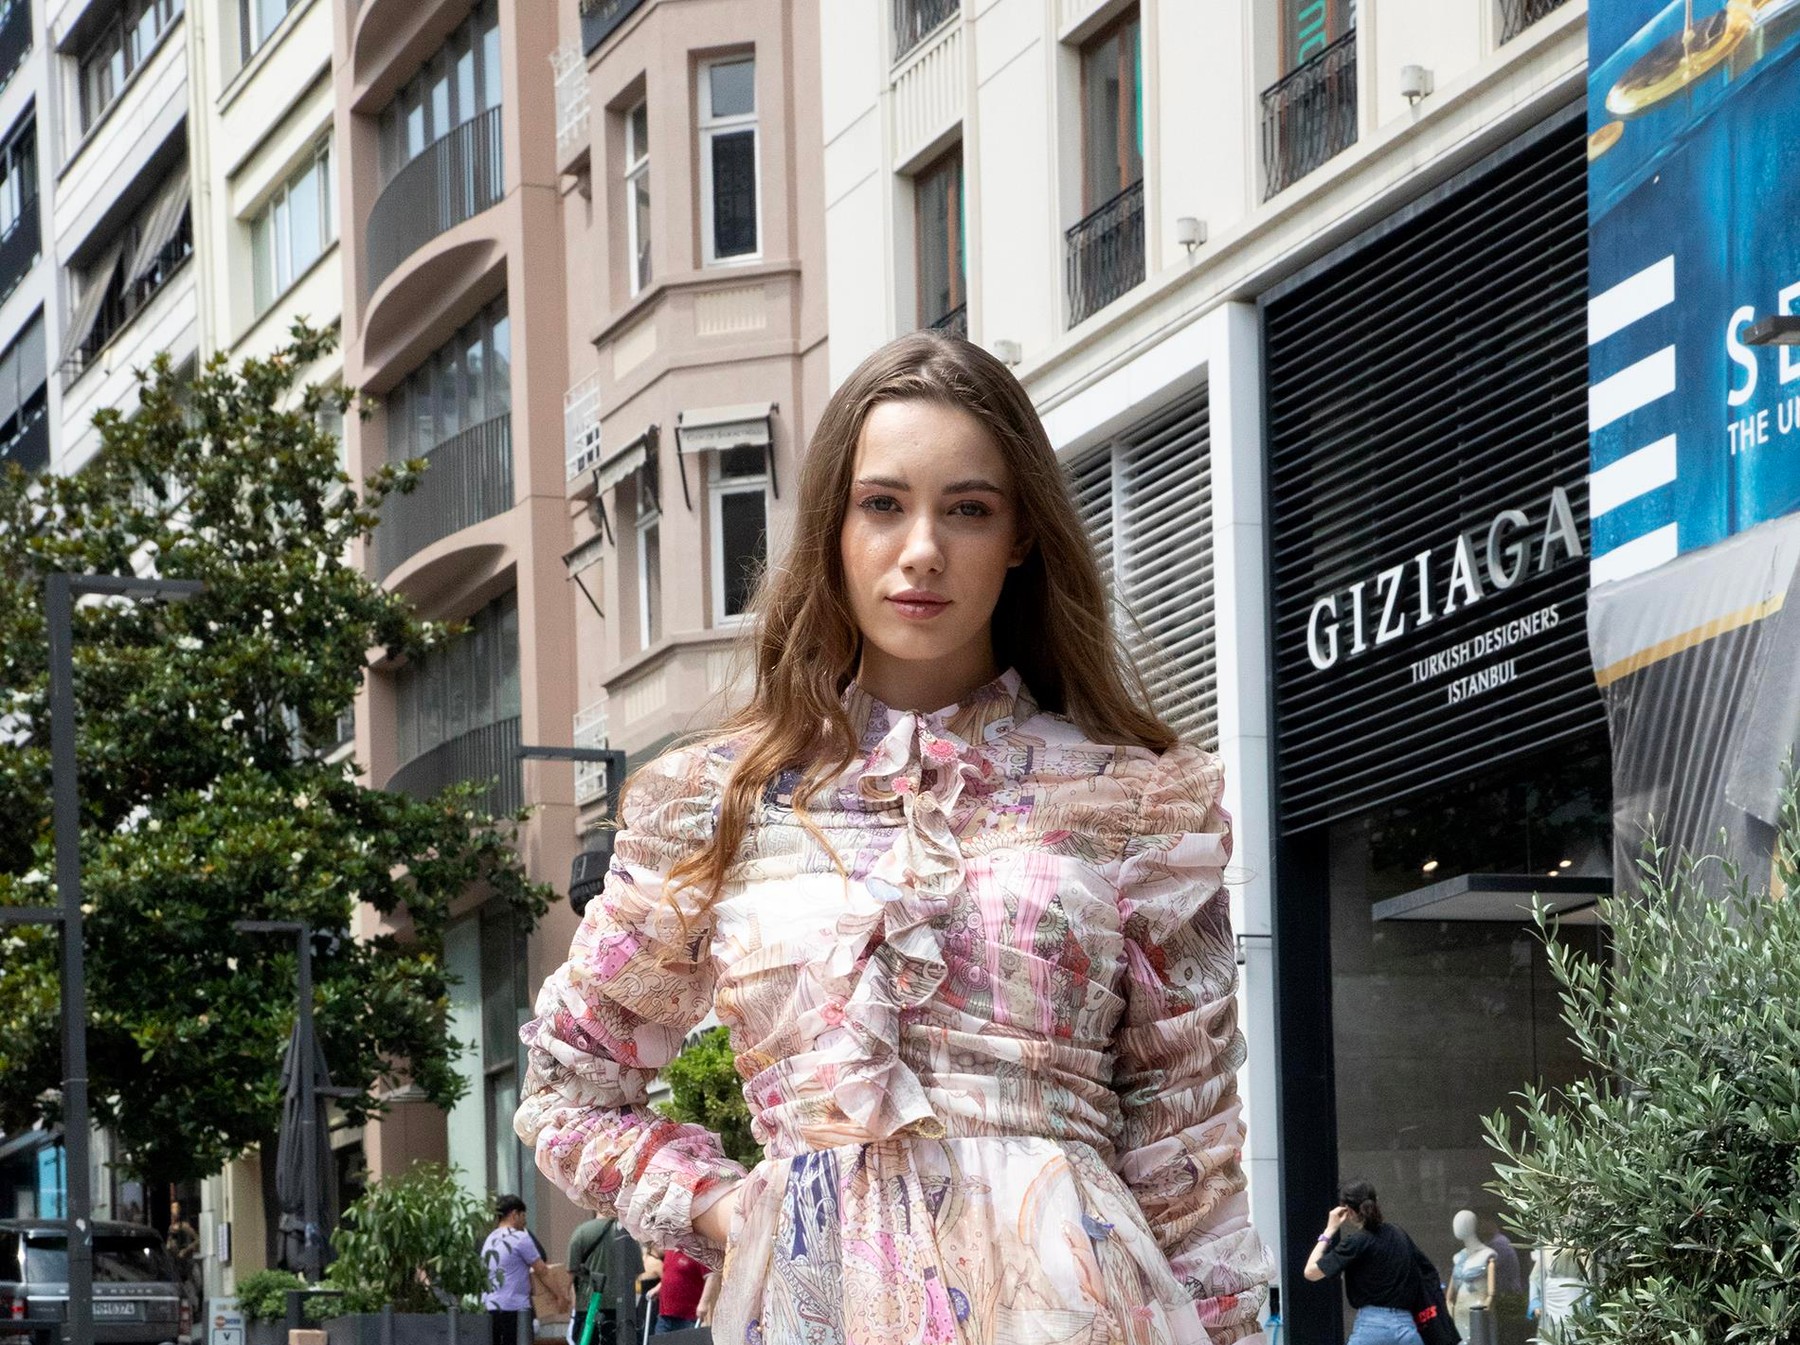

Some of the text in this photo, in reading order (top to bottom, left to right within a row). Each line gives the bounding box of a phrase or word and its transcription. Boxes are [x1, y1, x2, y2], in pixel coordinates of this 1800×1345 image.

[1727, 409, 1769, 455] THE
[1307, 476, 1589, 671] GIZIAGA
[1411, 604, 1559, 683] TURKISH DESIGNERS
[1448, 659, 1518, 704] ISTANBUL
